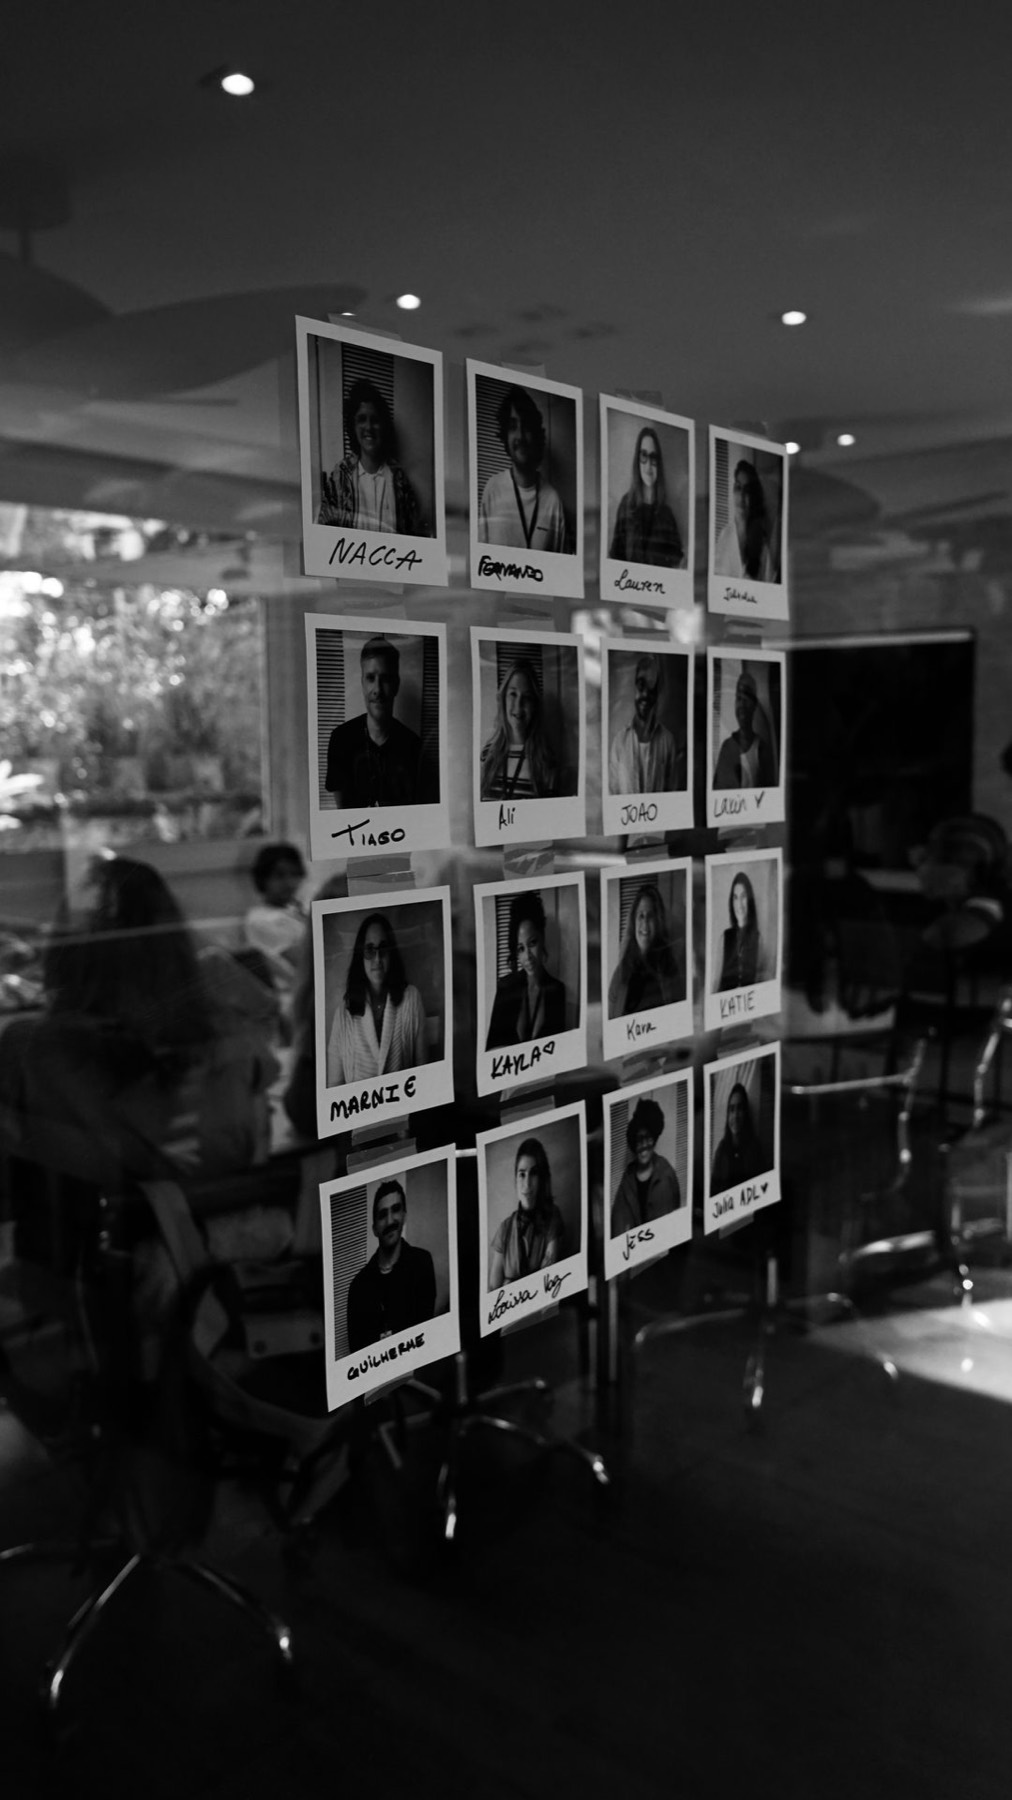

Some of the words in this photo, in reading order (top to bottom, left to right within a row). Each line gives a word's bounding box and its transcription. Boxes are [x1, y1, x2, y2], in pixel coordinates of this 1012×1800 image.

[328, 537, 423, 571] NACCA
[614, 568, 666, 594] Lauren
[499, 804, 515, 830] Ali
[331, 819, 405, 846] TIAGO
[720, 991, 755, 1019] KATIE
[627, 1020, 656, 1040] Kara
[490, 1046, 541, 1080] KAYLA
[330, 1076, 416, 1121] MARNIE
[347, 1333, 425, 1380] GUILHERME
